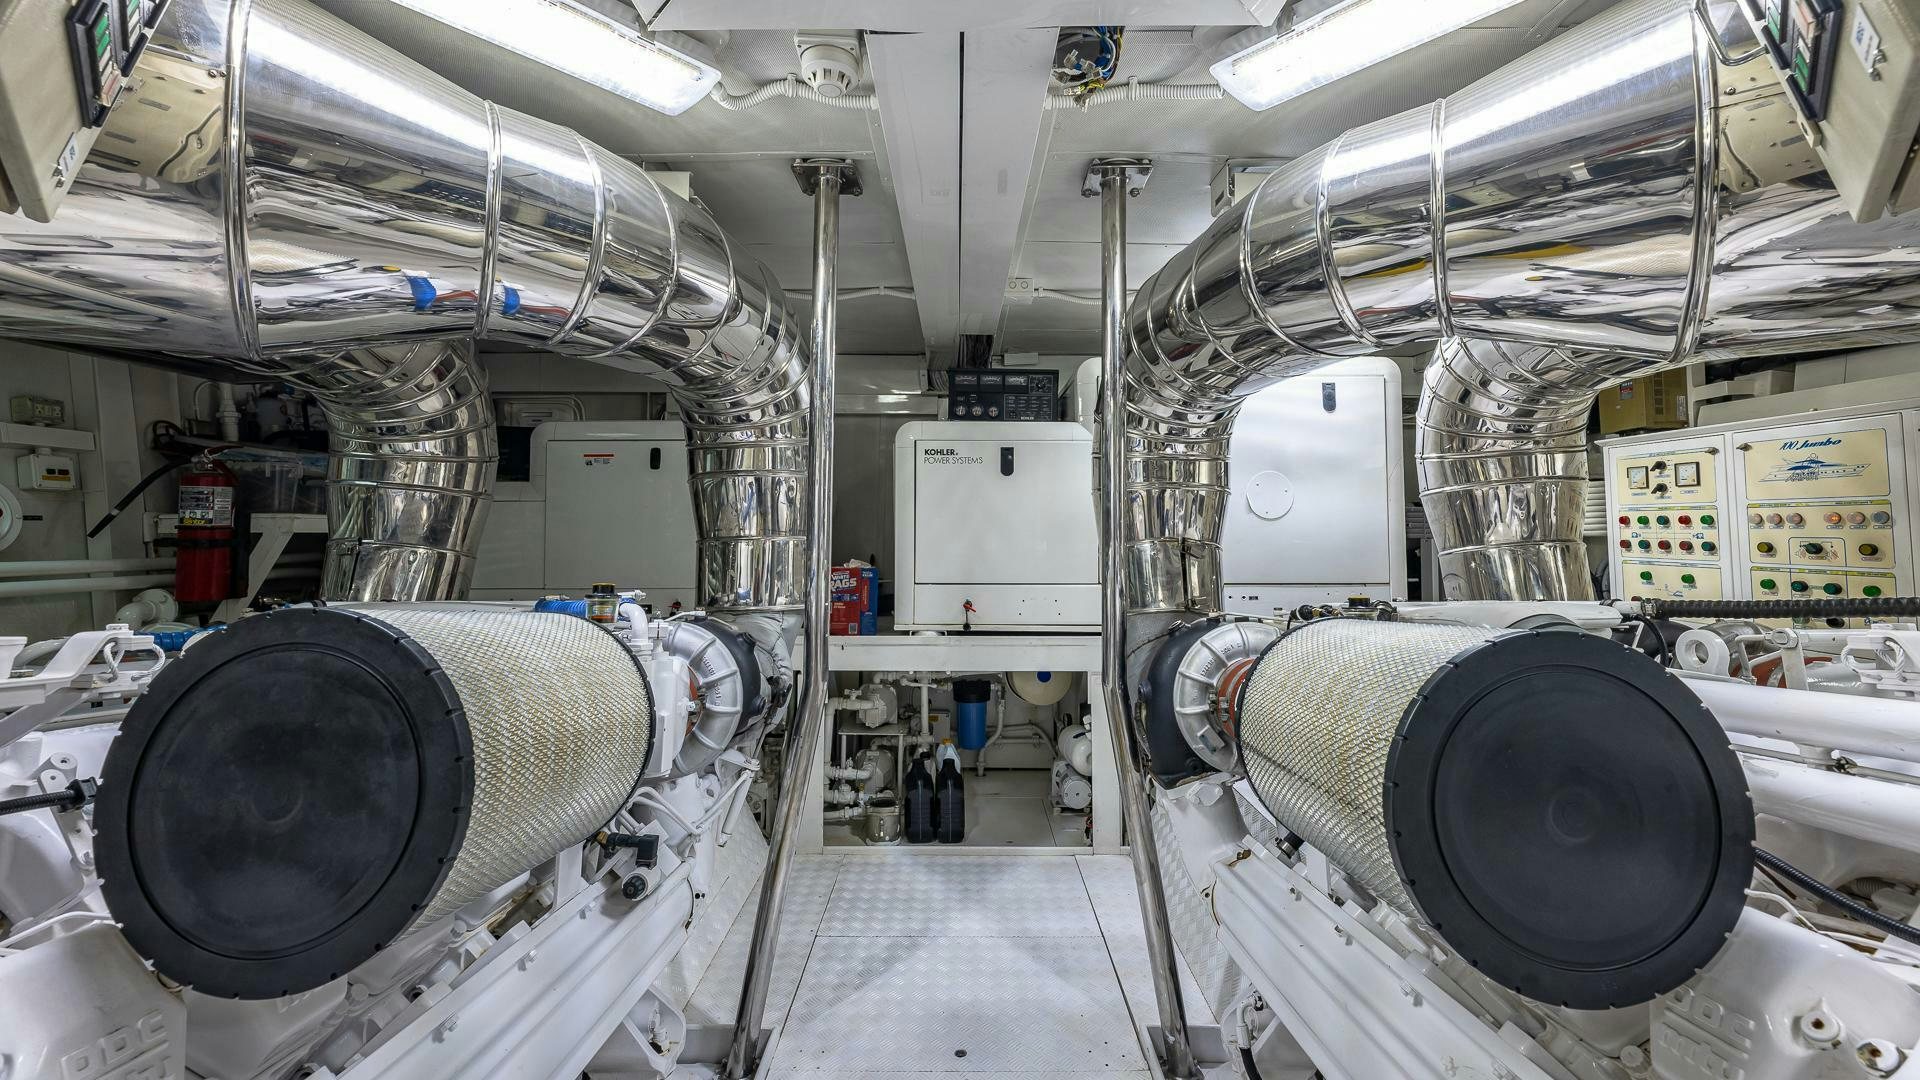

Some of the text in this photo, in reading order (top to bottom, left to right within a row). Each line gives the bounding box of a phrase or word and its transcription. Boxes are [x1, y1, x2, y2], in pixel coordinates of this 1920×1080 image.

[1795, 437, 1842, 450] Jumbo
[923, 456, 984, 465] POWER SYSTEMS
